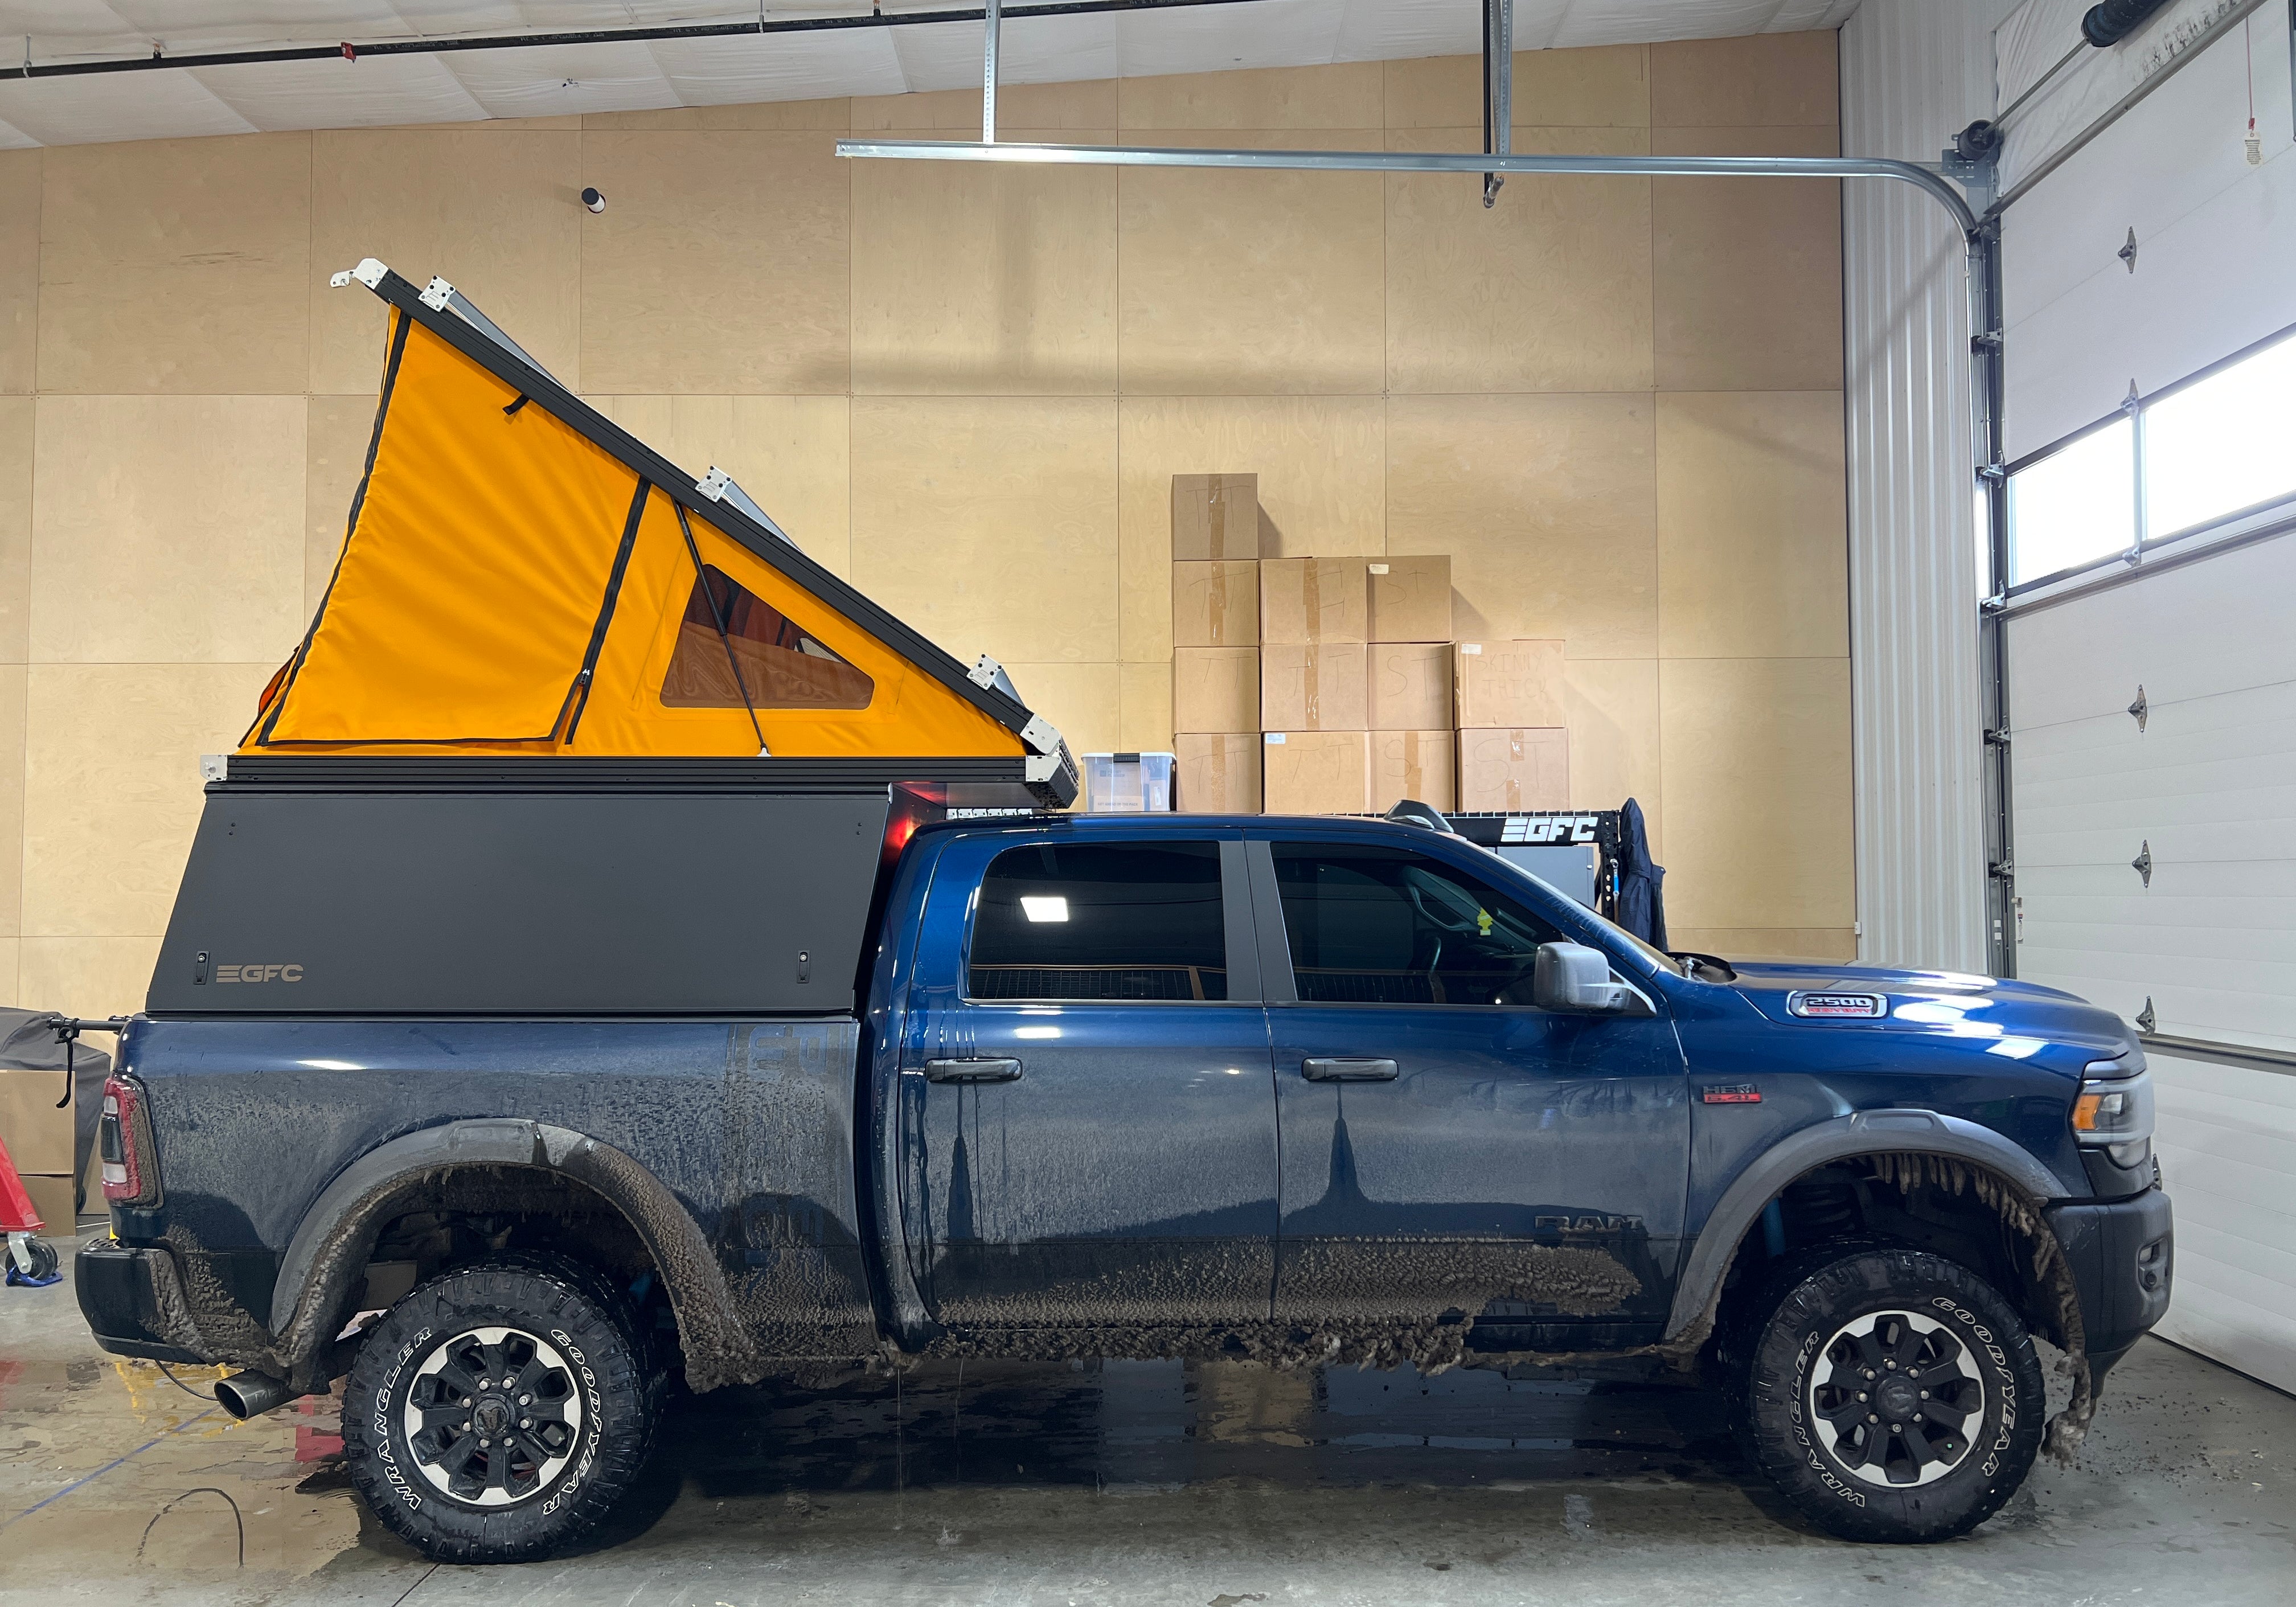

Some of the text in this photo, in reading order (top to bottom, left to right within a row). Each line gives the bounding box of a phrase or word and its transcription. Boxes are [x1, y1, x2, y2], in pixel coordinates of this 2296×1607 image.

[1387, 654, 1443, 701] ST
[1474, 653, 1543, 673] SKINNY
[1481, 676, 1548, 700] THICK
[1384, 738, 1448, 778] ST
[1473, 737, 1550, 793] ST
[1806, 998, 1872, 1007] 2500
[1534, 1215, 1643, 1231] RAM
[1932, 1297, 2017, 1477] GOODYEAR
[373, 1326, 432, 1511] WRANGLER
[543, 1329, 603, 1515] GOODYEAR
[1789, 1331, 1866, 1508] WRANGLER
